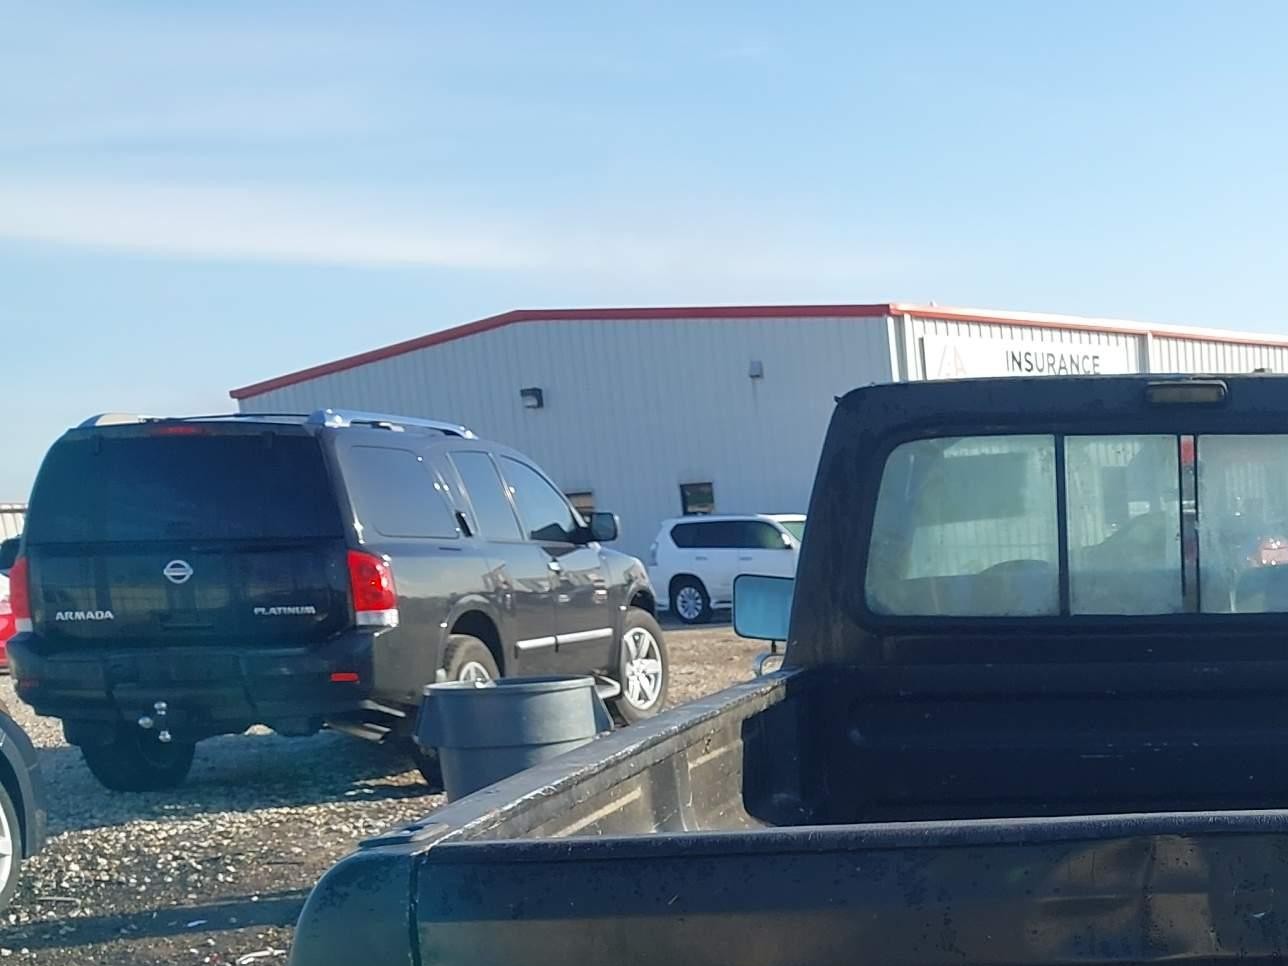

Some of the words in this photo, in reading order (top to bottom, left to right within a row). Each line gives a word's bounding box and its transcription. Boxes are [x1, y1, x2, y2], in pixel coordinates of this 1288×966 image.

[1005, 350, 1101, 375] INSURANCE
[55, 610, 114, 621] ARMADA
[253, 605, 316, 615] PLATINUM
